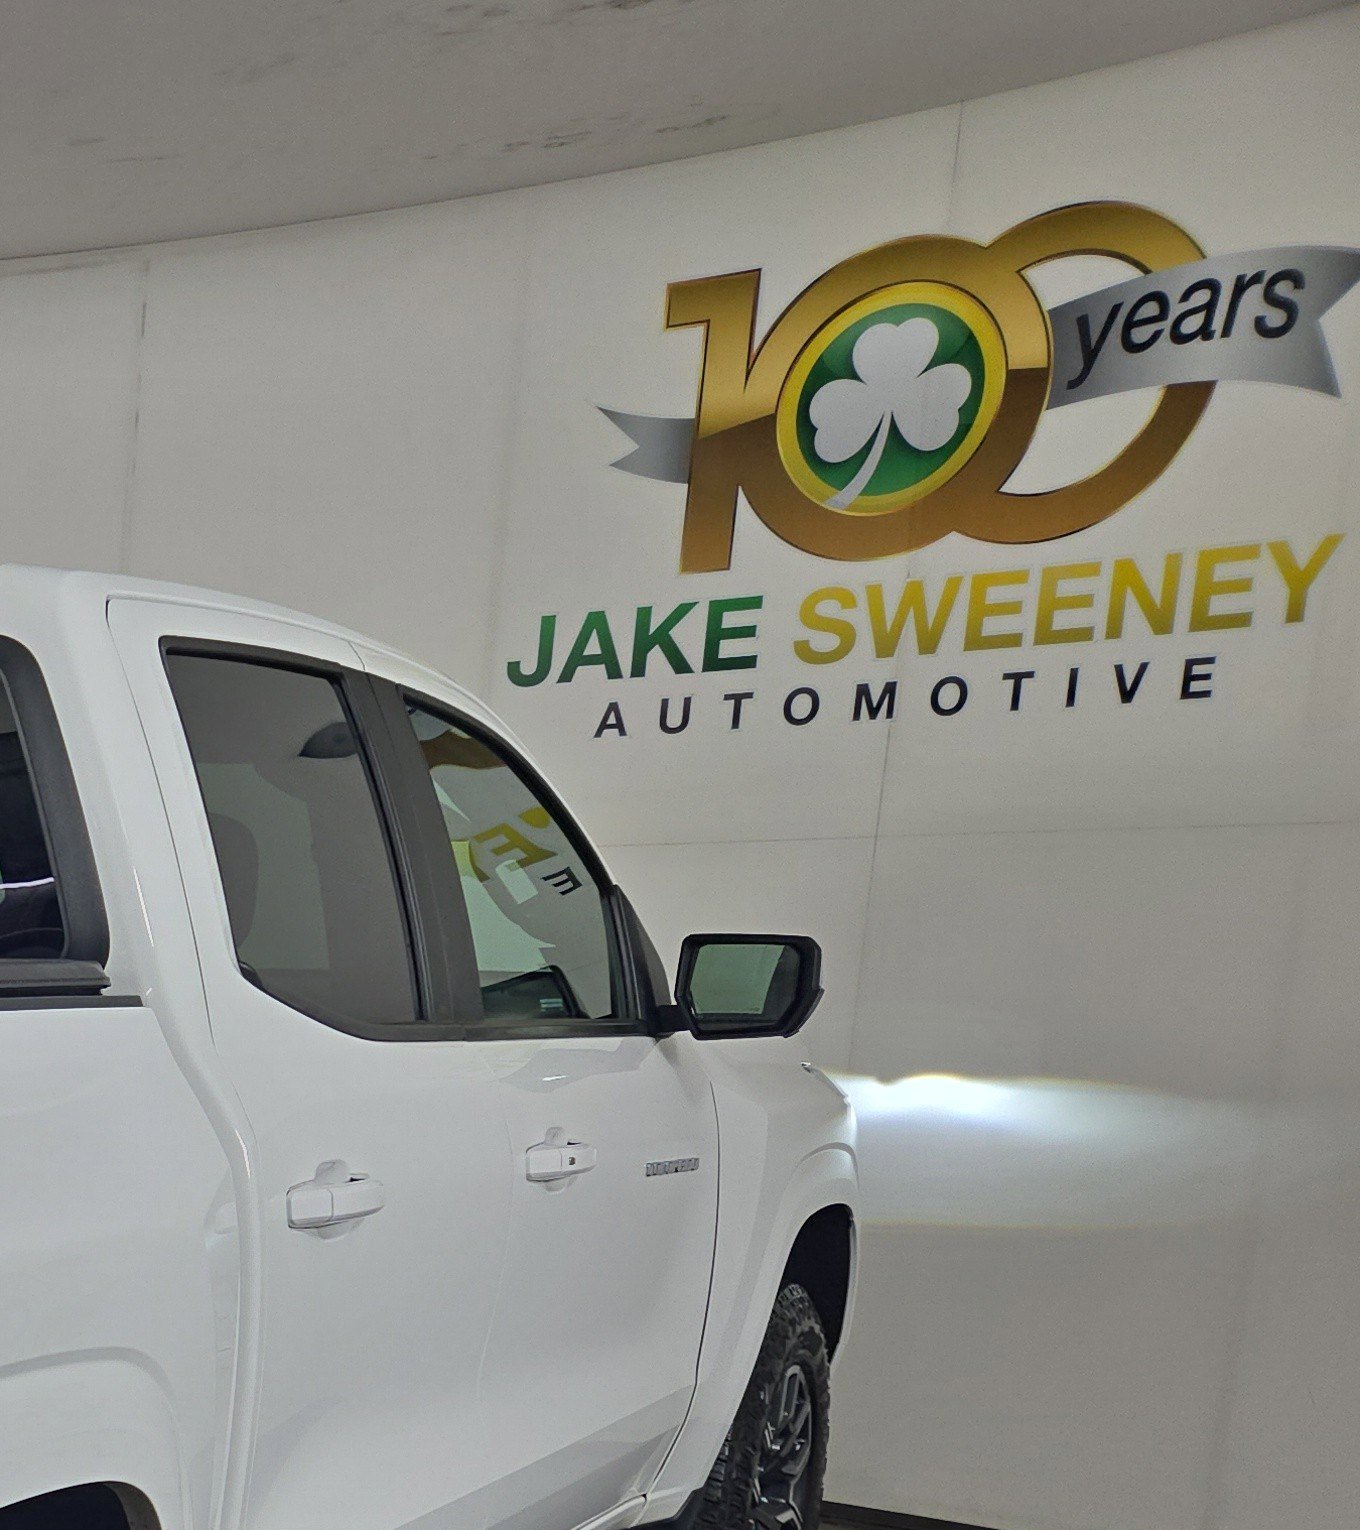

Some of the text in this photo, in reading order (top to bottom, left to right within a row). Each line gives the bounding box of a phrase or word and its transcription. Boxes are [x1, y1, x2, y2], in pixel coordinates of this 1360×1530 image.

[664, 200, 1305, 574] 100 years
[506, 533, 1344, 688] JAKE SWEENEY
[593, 656, 1217, 739] AUTOMOTIVE
